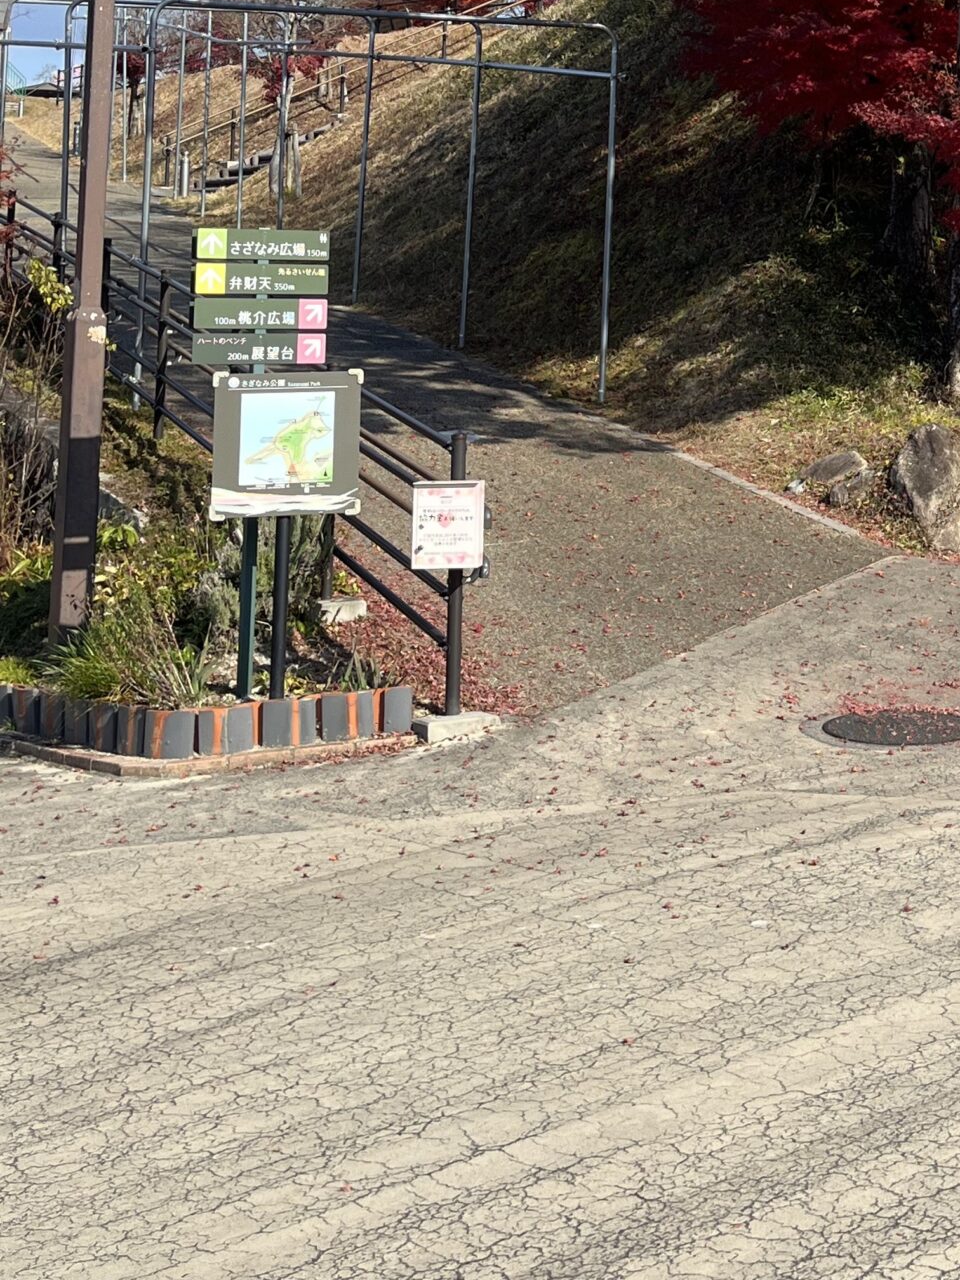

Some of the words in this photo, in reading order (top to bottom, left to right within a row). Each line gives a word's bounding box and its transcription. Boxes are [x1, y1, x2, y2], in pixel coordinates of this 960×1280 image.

[230, 241, 306, 257] さざなみ広場
[306, 249, 328, 257] 150m
[229, 276, 272, 290] 弁財天
[274, 283, 295, 291] 350m
[214, 317, 236, 325] 100m
[238, 311, 295, 325] 桃介広場
[227, 352, 249, 361] 200m
[251, 346, 294, 361] 展望台
[241, 379, 286, 388] さざなみ公園
